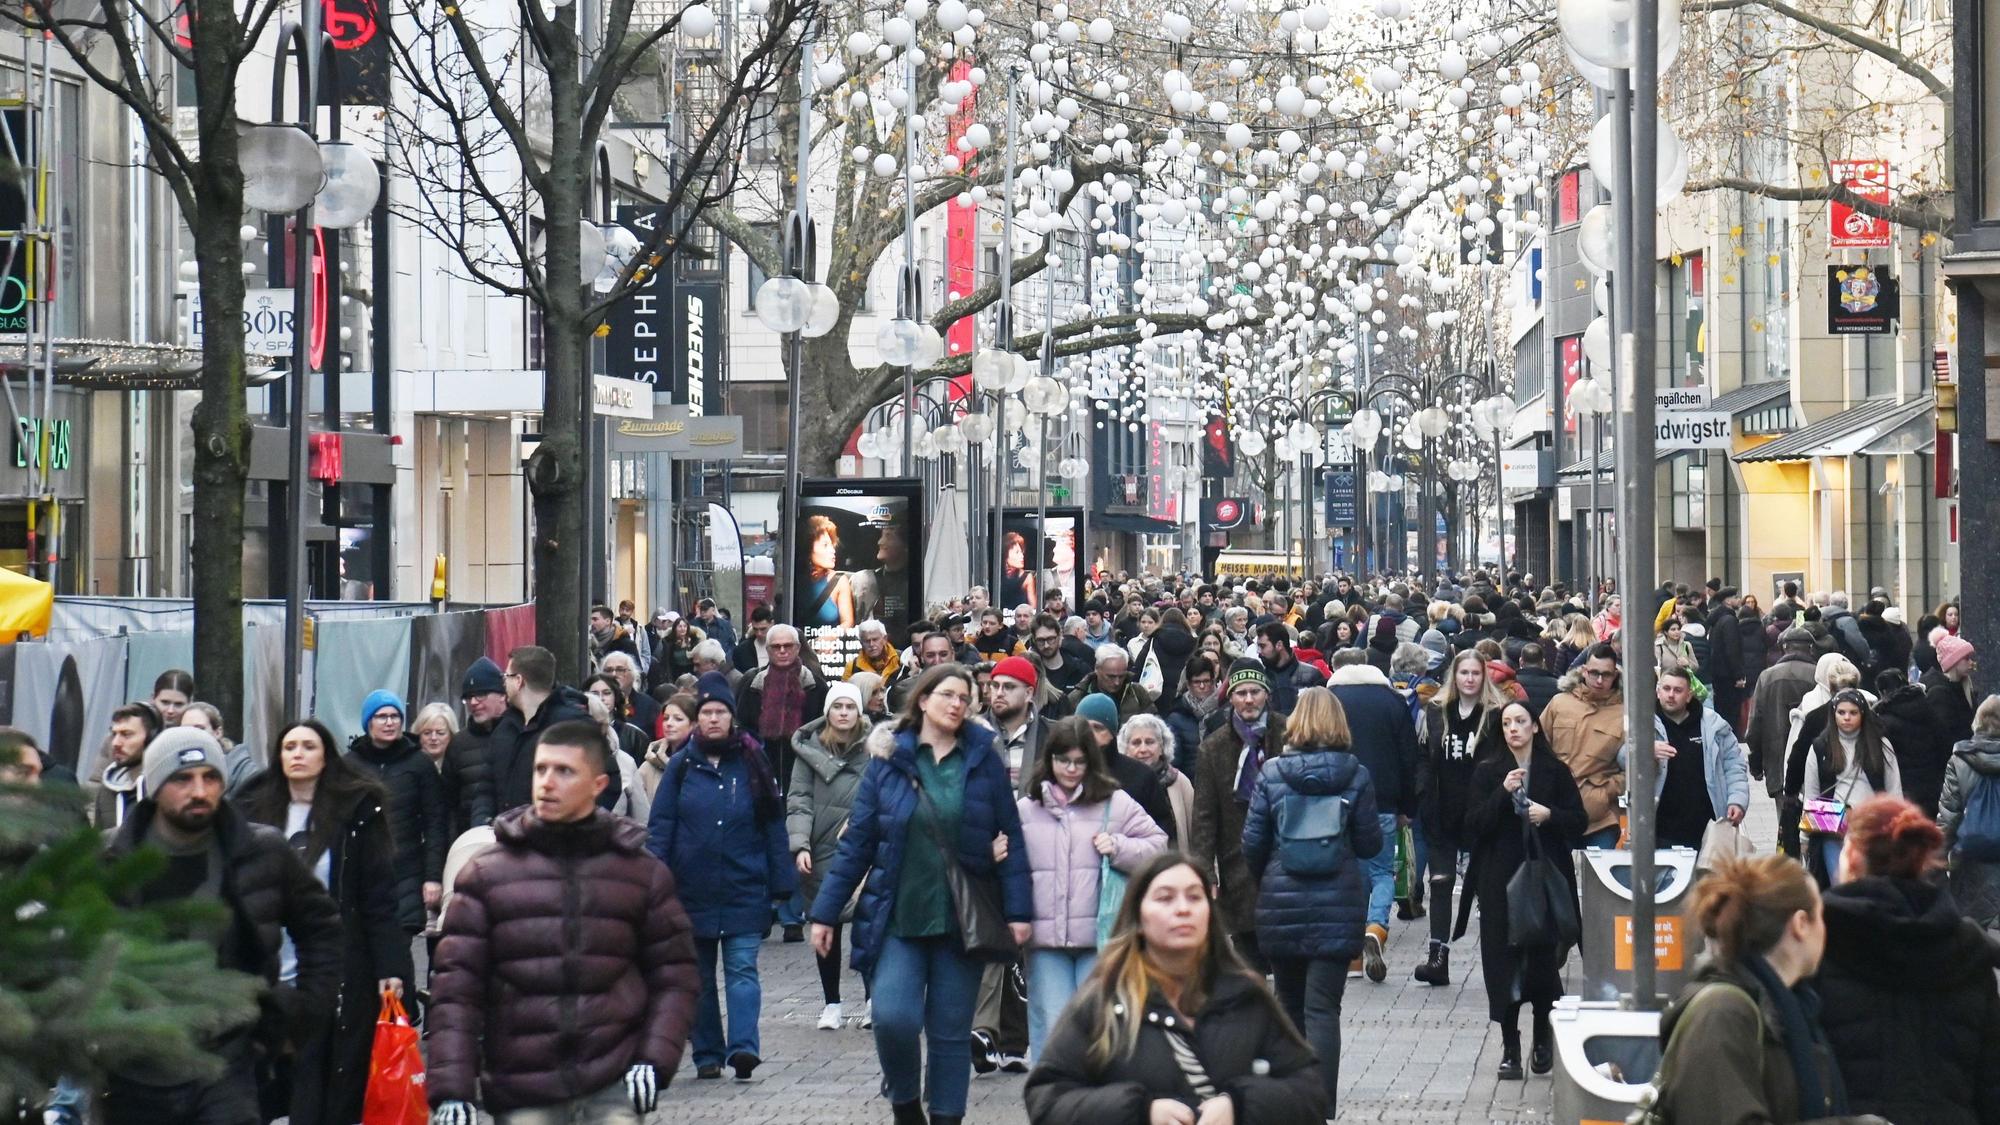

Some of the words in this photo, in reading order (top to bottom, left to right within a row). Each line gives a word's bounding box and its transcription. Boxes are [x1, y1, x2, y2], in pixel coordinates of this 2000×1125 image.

[1832, 163, 1886, 187] FC
[634, 212, 657, 384] SEPHOA
[872, 506, 889, 515] dm
[1220, 563, 1250, 573] HEISSE
[1254, 565, 1298, 574] MARONN
[804, 625, 844, 637] Endlich
